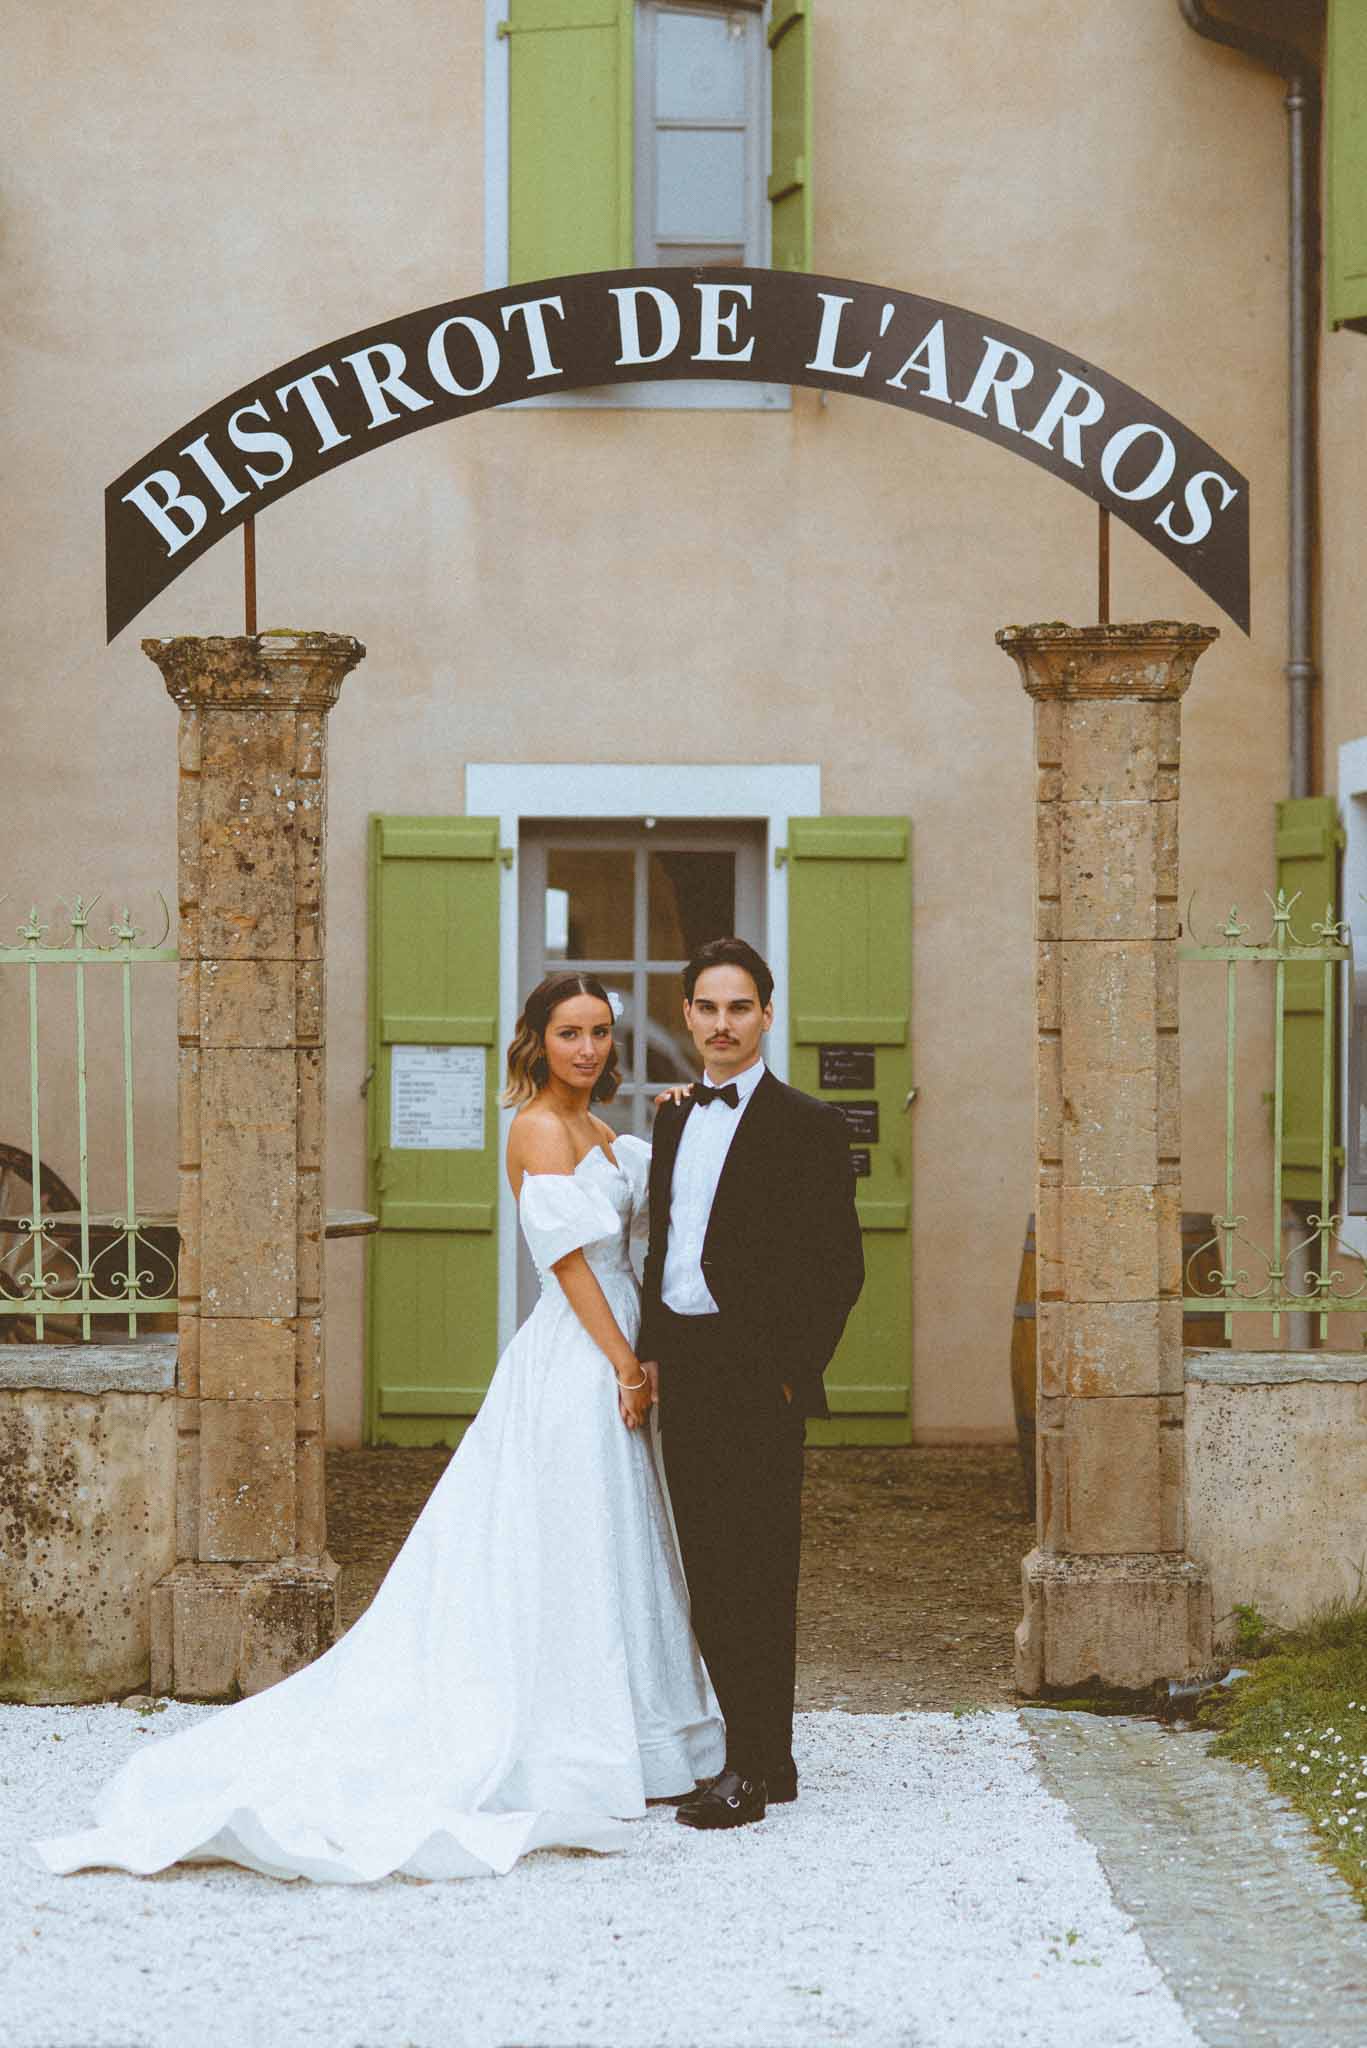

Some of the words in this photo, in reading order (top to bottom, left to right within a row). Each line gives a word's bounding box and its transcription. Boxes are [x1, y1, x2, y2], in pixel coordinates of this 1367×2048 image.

[121, 295, 565, 558] BISTROT
[608, 283, 755, 366] DE
[805, 292, 1238, 545] L'ARROS
